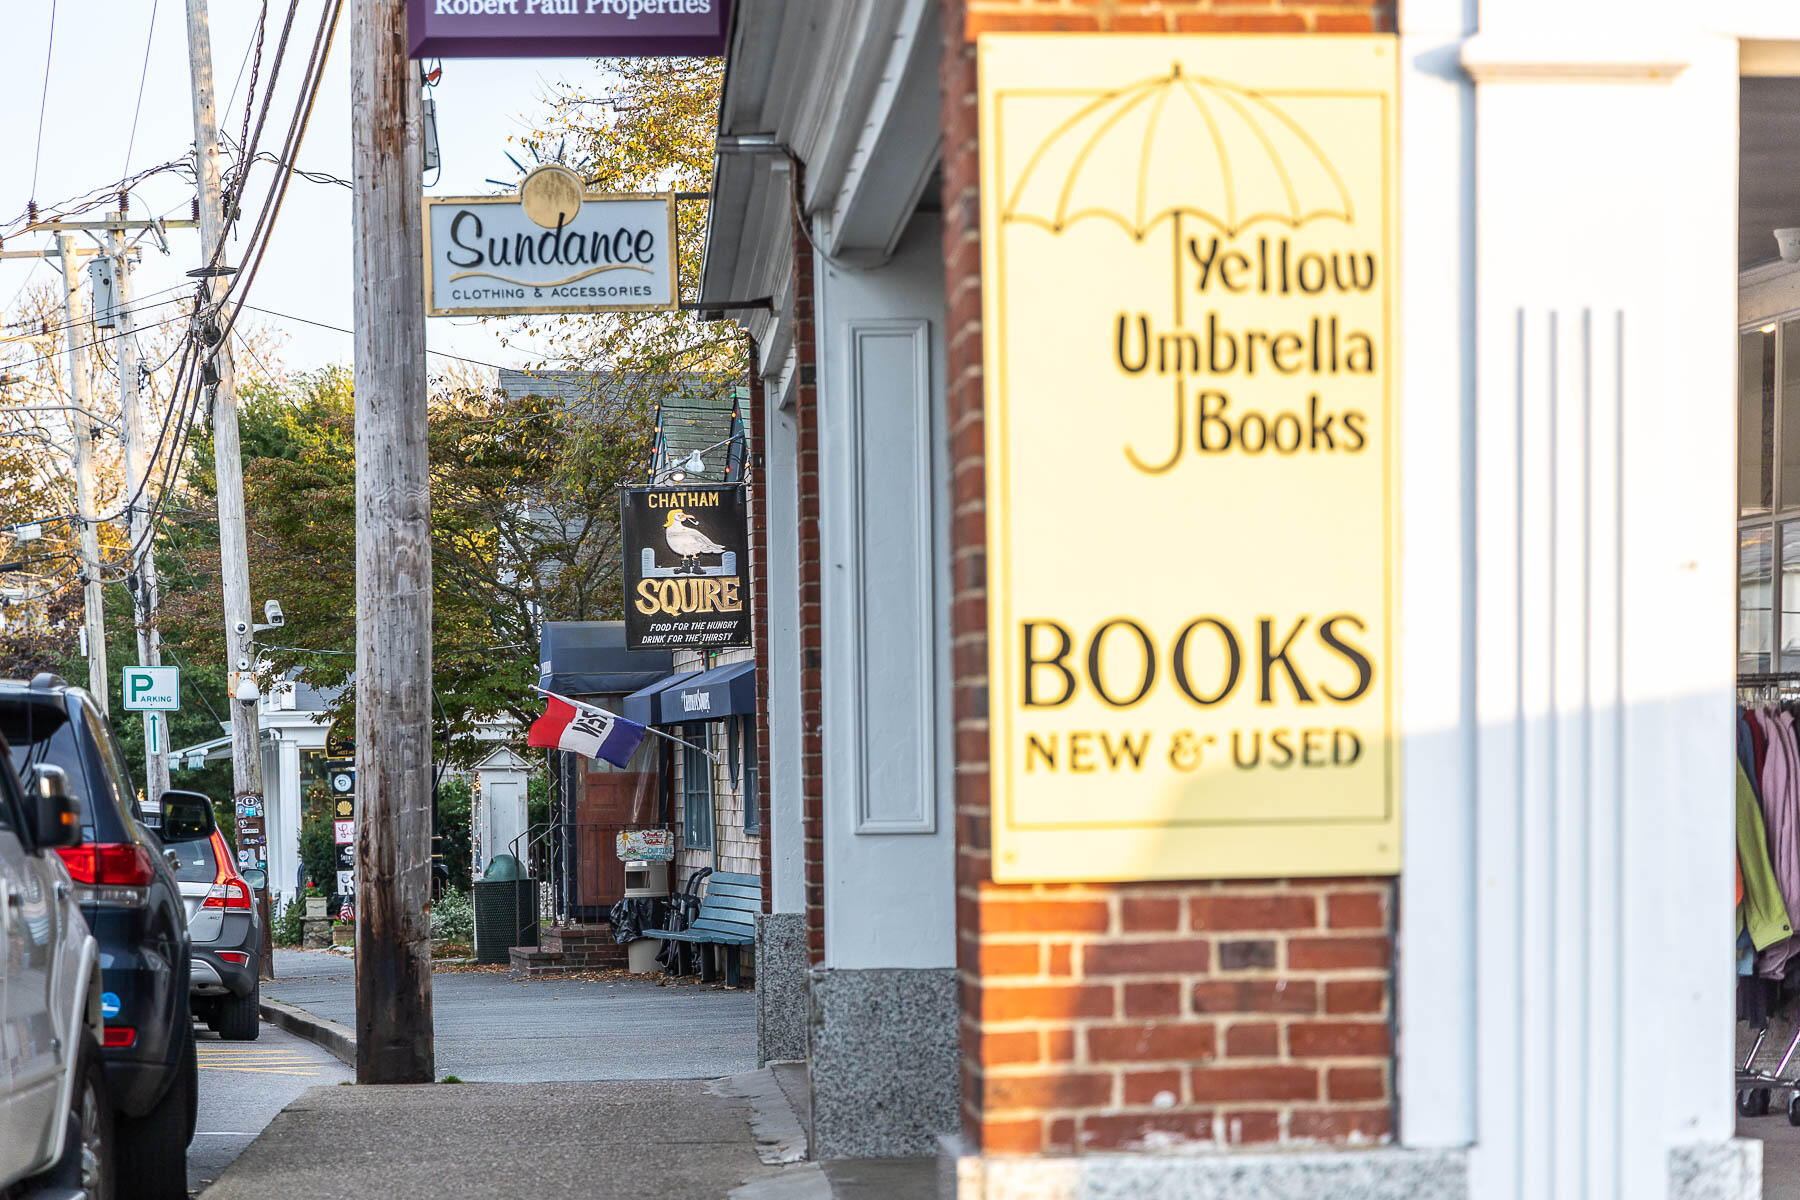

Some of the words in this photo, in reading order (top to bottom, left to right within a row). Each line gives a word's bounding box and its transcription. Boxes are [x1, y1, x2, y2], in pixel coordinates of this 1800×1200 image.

[434, 0, 519, 15] Robert
[524, 0, 579, 15] Paul
[584, 0, 711, 20] Properties
[447, 210, 655, 268] Sundance
[1187, 235, 1377, 296] Yellow
[452, 289, 525, 300] CLOTHING
[533, 288, 543, 298] &
[551, 286, 652, 298] ACCESSORIES
[1114, 311, 1376, 376] Umbrella
[1197, 390, 1369, 455] Books
[648, 491, 719, 508] CHATHAM
[634, 576, 743, 617] SQUIRE
[641, 634, 666, 644] DRINK
[667, 634, 683, 643] FOR
[684, 632, 701, 643] THE
[701, 632, 733, 642] THIRSTY
[650, 623, 672, 632] FOOD
[672, 622, 689, 631] FOR
[690, 621, 707, 631] THE
[706, 620, 739, 630] HUNGRY
[1022, 616, 1373, 707] BOOKS
[1025, 732, 1150, 772] NEW
[1168, 731, 1217, 771] &
[1233, 729, 1364, 770] USED
